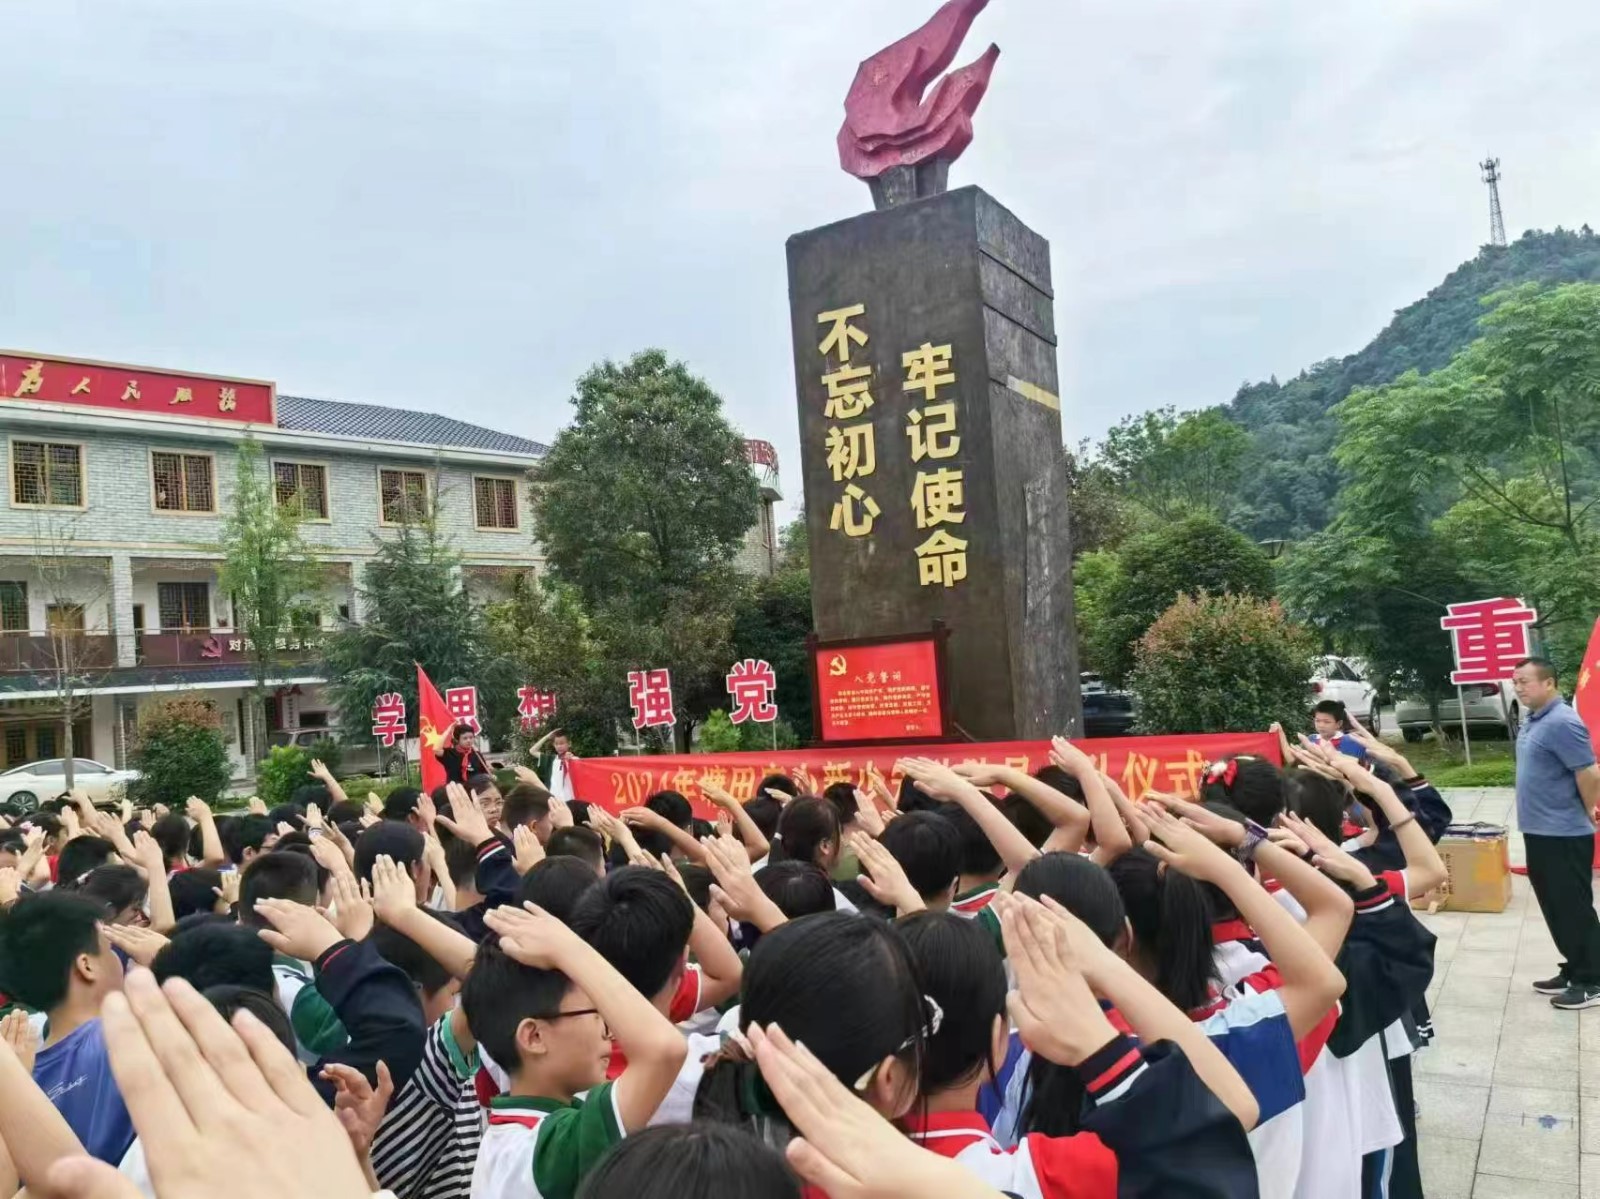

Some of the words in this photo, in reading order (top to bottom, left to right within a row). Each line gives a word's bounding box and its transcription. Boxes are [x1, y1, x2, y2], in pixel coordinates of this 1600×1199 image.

[818, 303, 882, 537] 不忘初心
[902, 342, 968, 587] 牢记使命
[1441, 597, 1537, 684] 重
